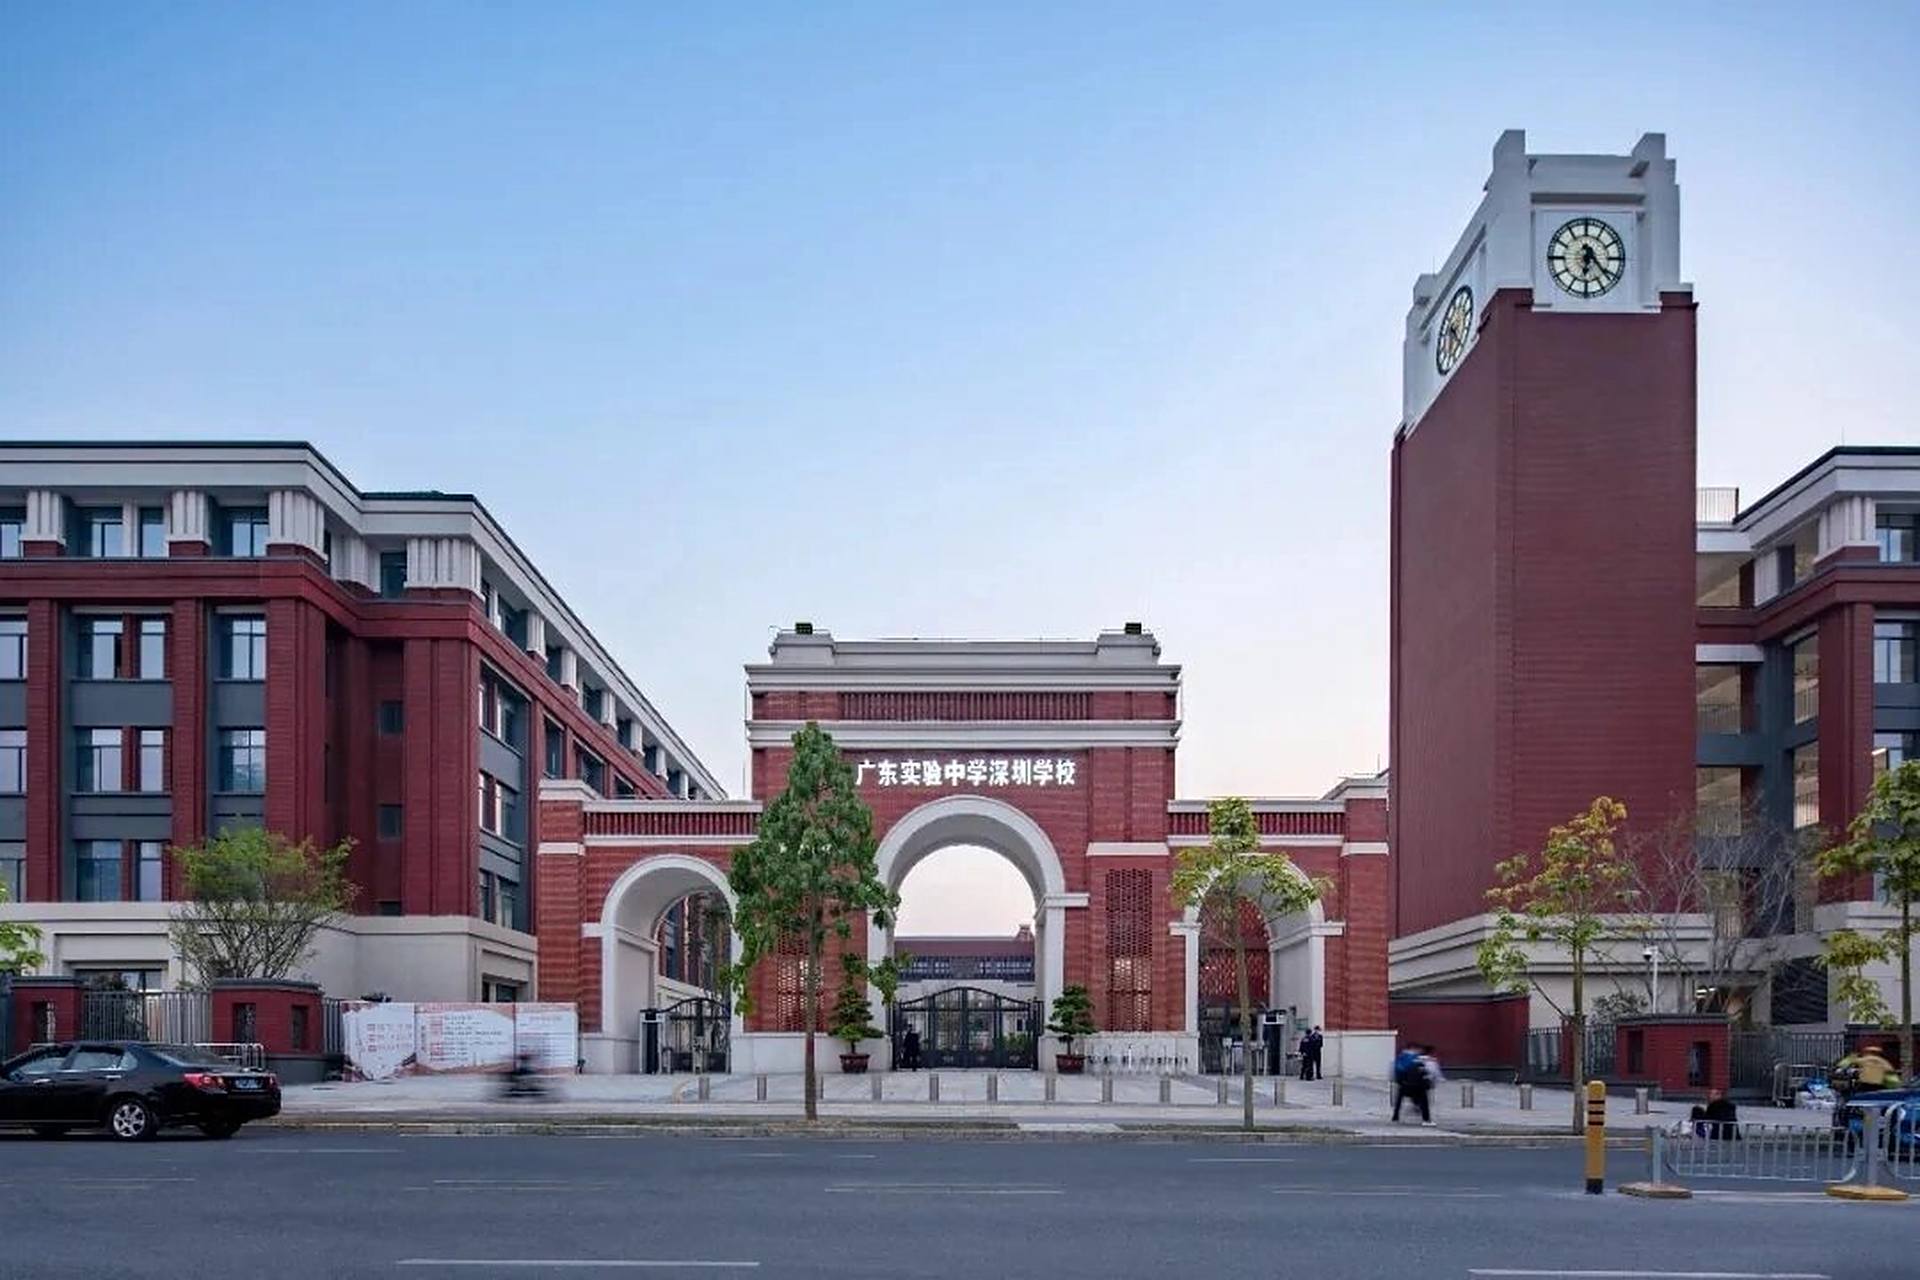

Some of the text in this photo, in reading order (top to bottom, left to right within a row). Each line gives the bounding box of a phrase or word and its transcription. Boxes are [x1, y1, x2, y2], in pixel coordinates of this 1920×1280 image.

[856, 759, 1075, 785] 广东实验中学深圳学校
